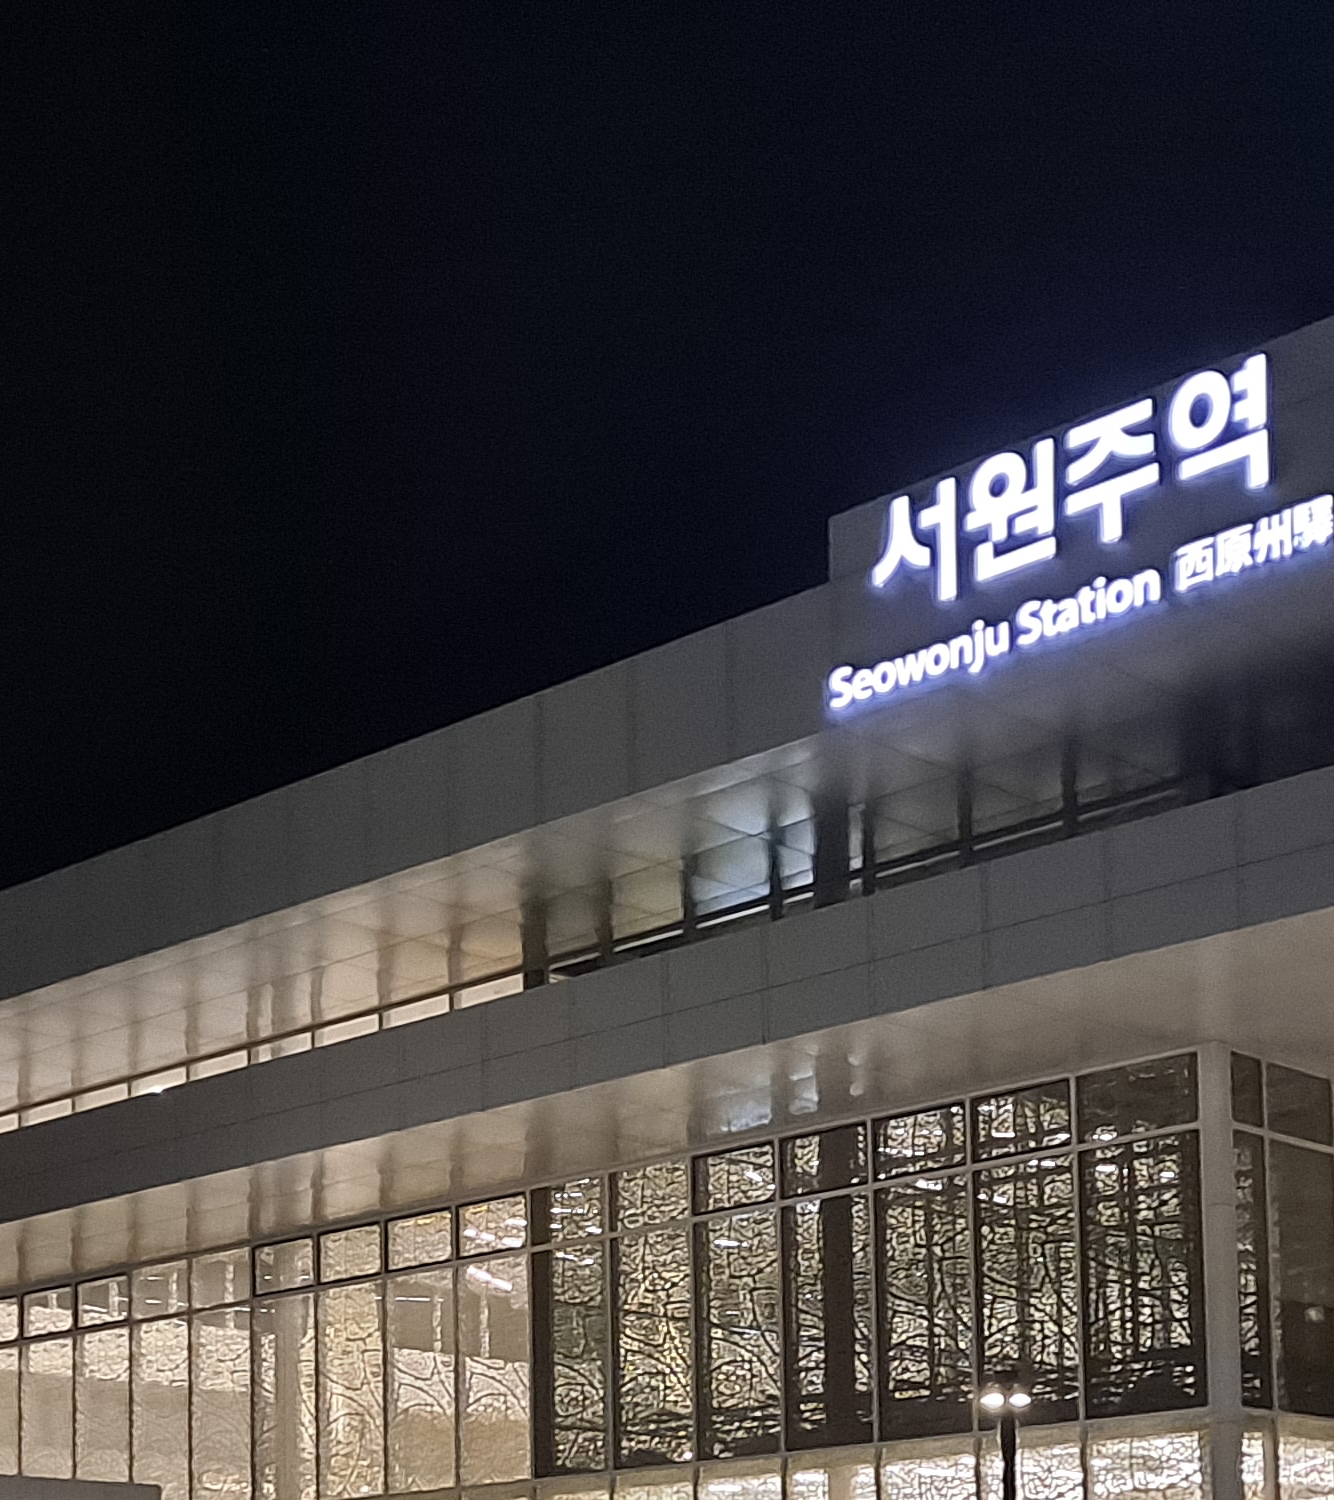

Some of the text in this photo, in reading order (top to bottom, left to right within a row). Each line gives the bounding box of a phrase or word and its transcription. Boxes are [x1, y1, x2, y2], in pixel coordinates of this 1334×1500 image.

[871, 353, 1270, 602] 서원주역
[828, 569, 1161, 709] Seowonju Station
